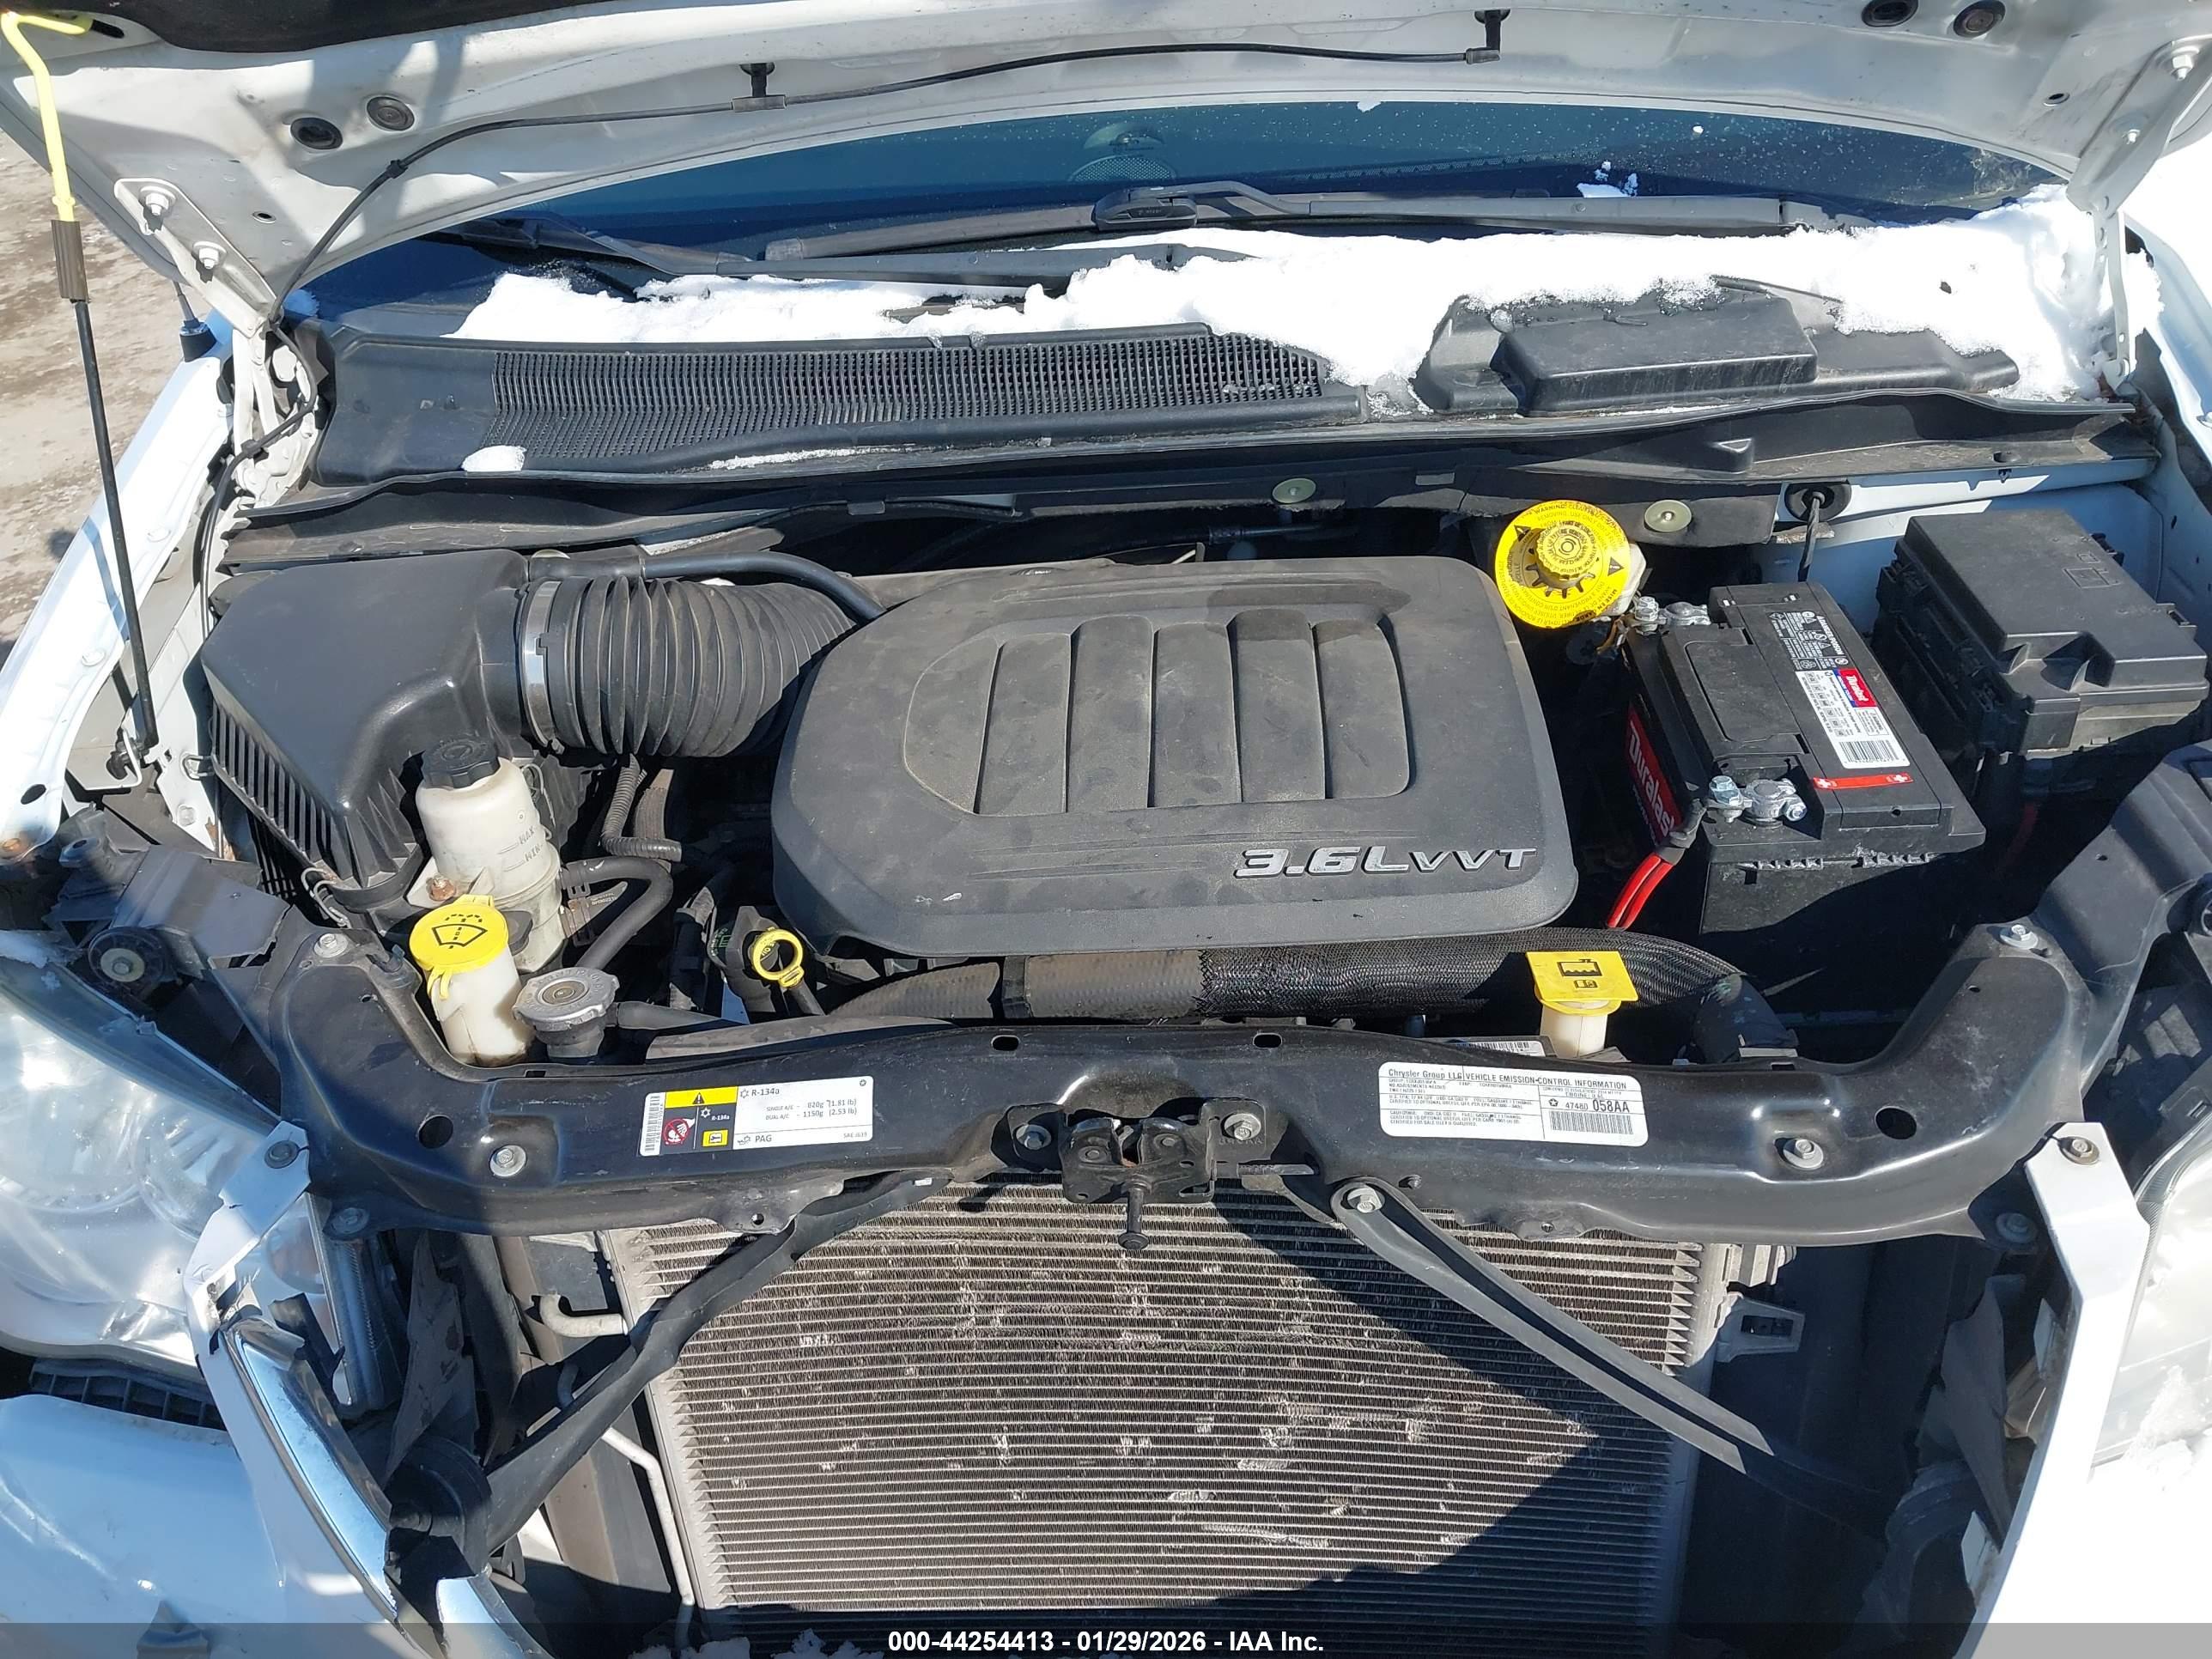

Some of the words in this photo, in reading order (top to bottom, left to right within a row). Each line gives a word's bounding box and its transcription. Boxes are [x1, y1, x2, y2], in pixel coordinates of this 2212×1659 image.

[1845, 675, 1869, 702] Duralast
[1629, 720, 1674, 837] Duralas
[1234, 846, 1409, 878] 3.6L
[1409, 848, 1538, 873] VVT
[1389, 1068, 1420, 1079] Chrysler
[1422, 1070, 1446, 1079] Group
[1465, 1072, 1497, 1082] VEHICLE
[1574, 1079, 1627, 1090] INFORMATION
[751, 1087, 780, 1097] R-134a
[1592, 1099, 1630, 1113] 058AA
[803, 1110, 823, 1119] 1150g
[829, 1109, 847, 1117] (2.53
[755, 1134, 772, 1143] PAG
